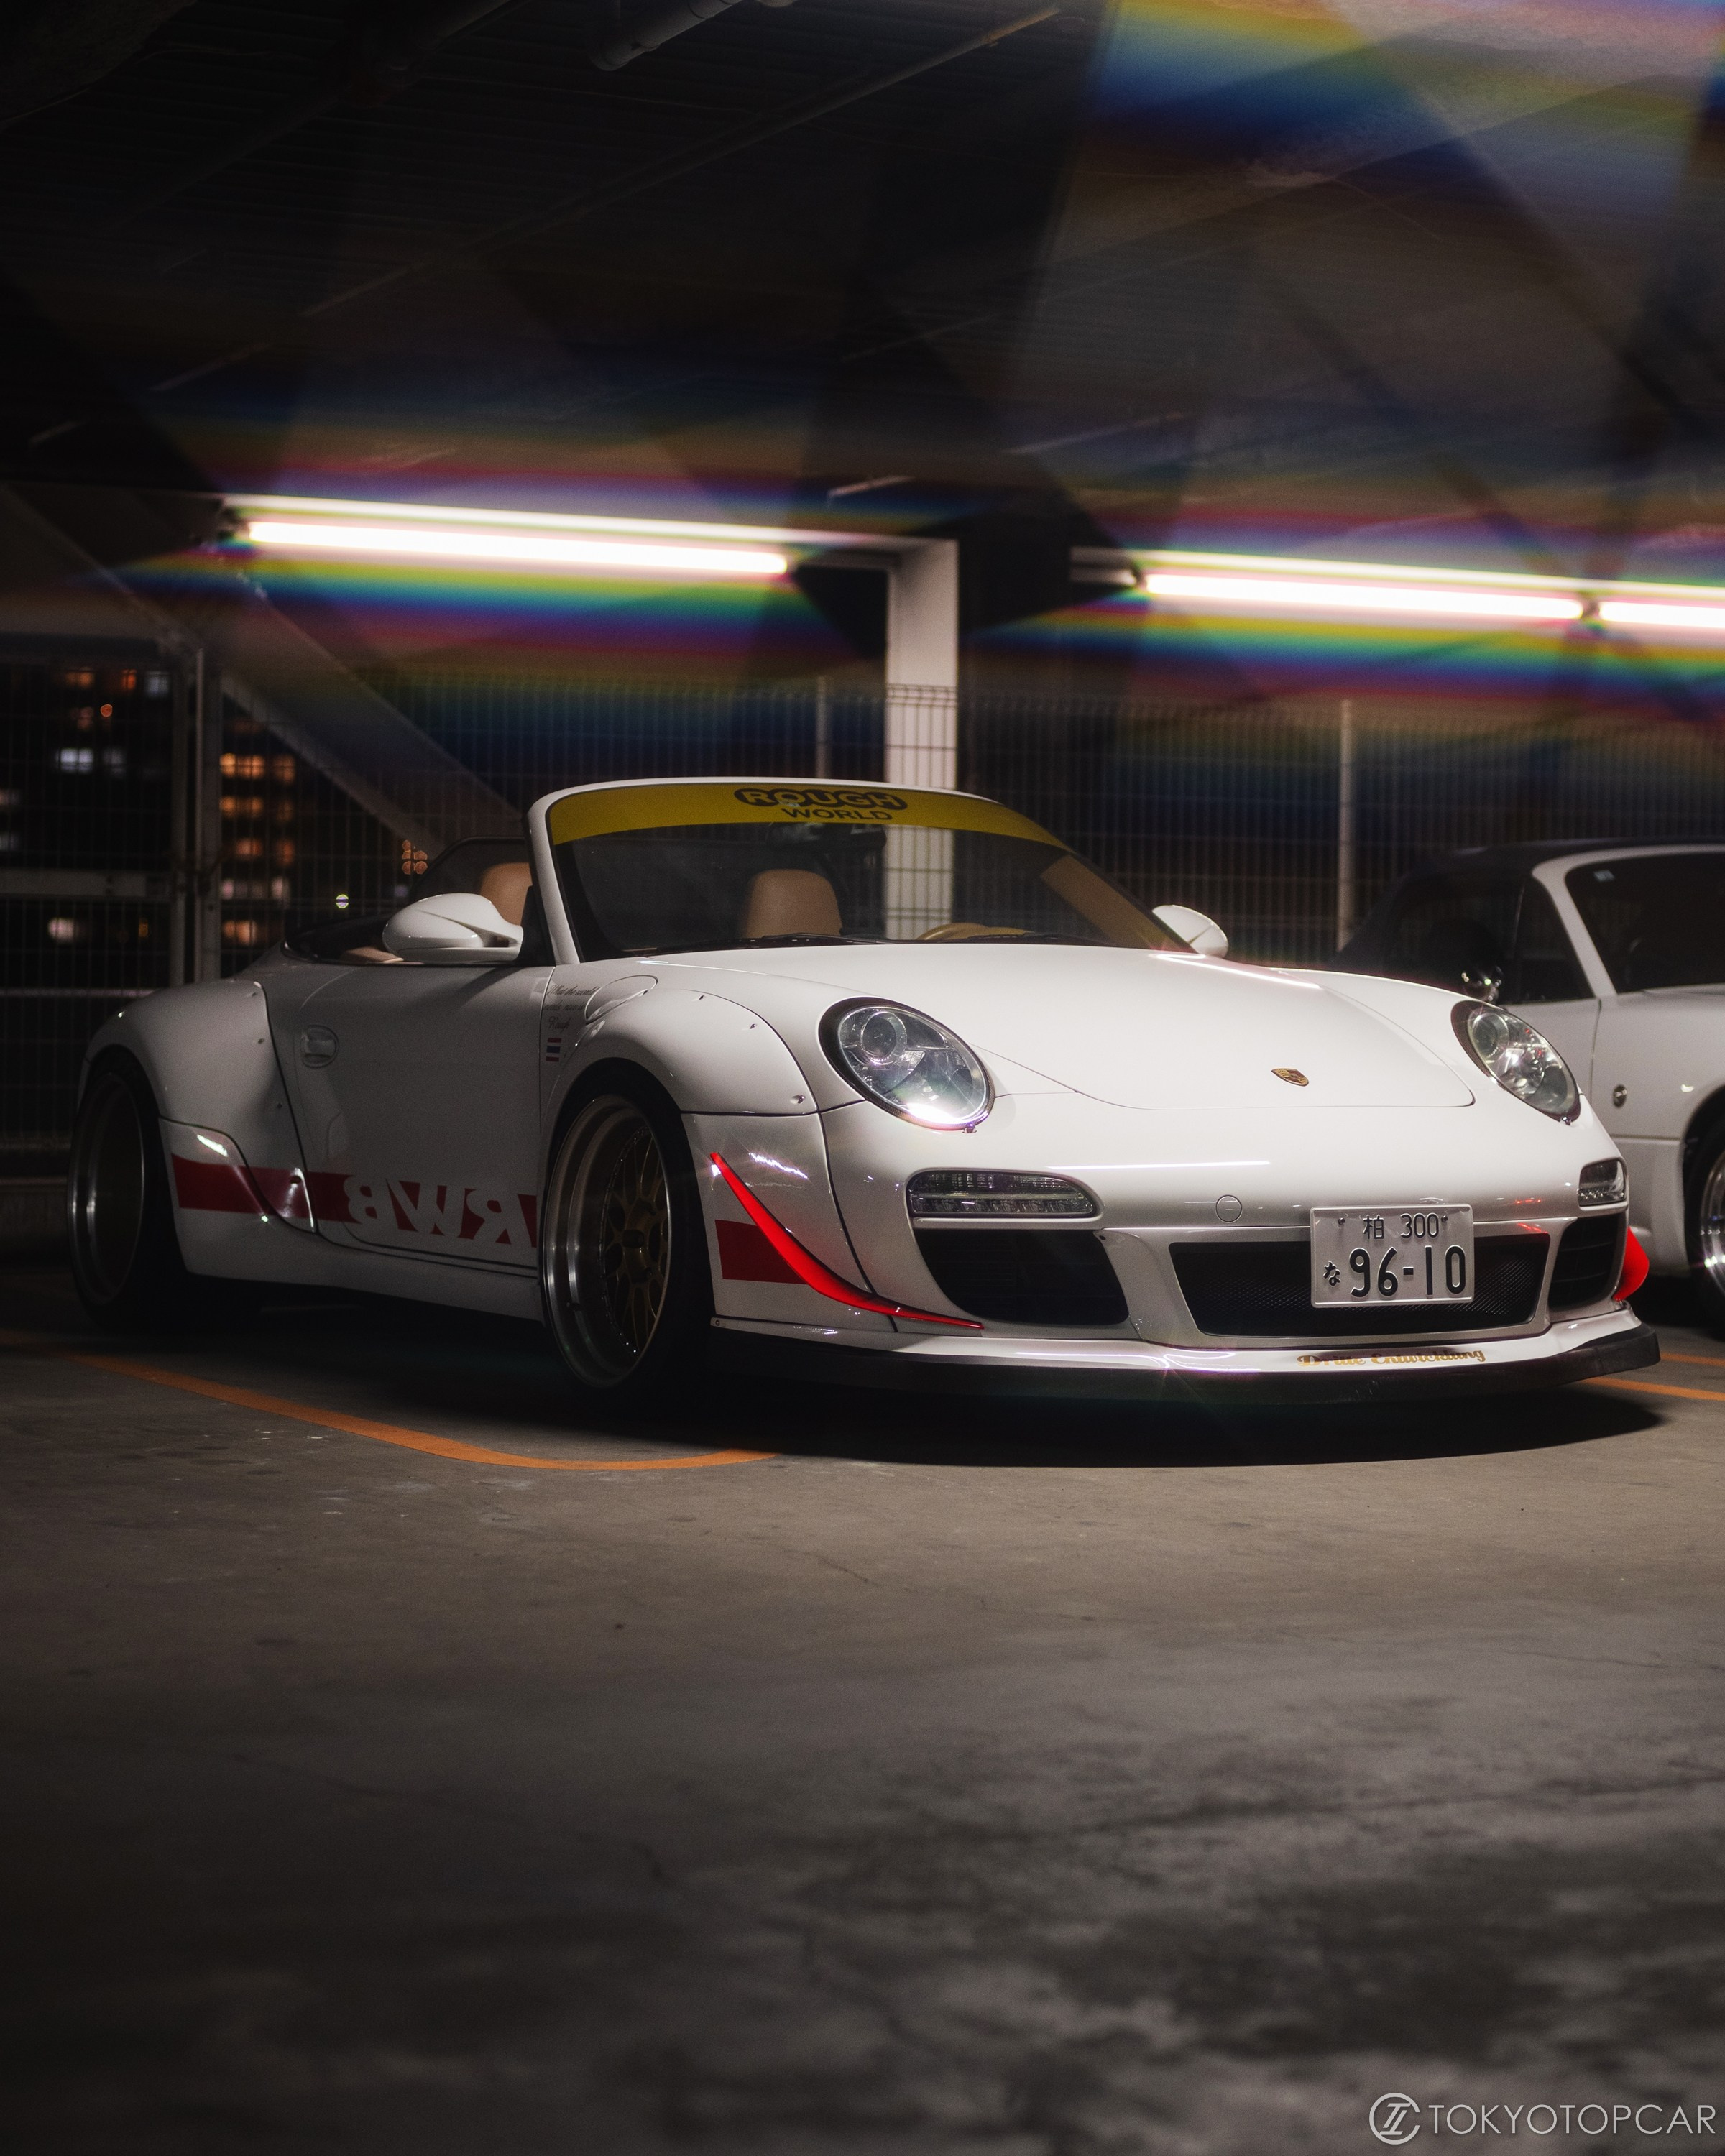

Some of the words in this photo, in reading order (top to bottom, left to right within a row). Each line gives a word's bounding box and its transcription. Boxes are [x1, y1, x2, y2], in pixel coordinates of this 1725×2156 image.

[735, 788, 906, 809] ROUGH
[781, 808, 893, 821] WORLD
[1363, 1214, 1384, 1240] 柏
[1400, 1212, 1440, 1239] 300
[1323, 1261, 1341, 1286] な
[1349, 1244, 1467, 1298] 96-10
[1371, 1348, 1486, 1365] Entwicklung
